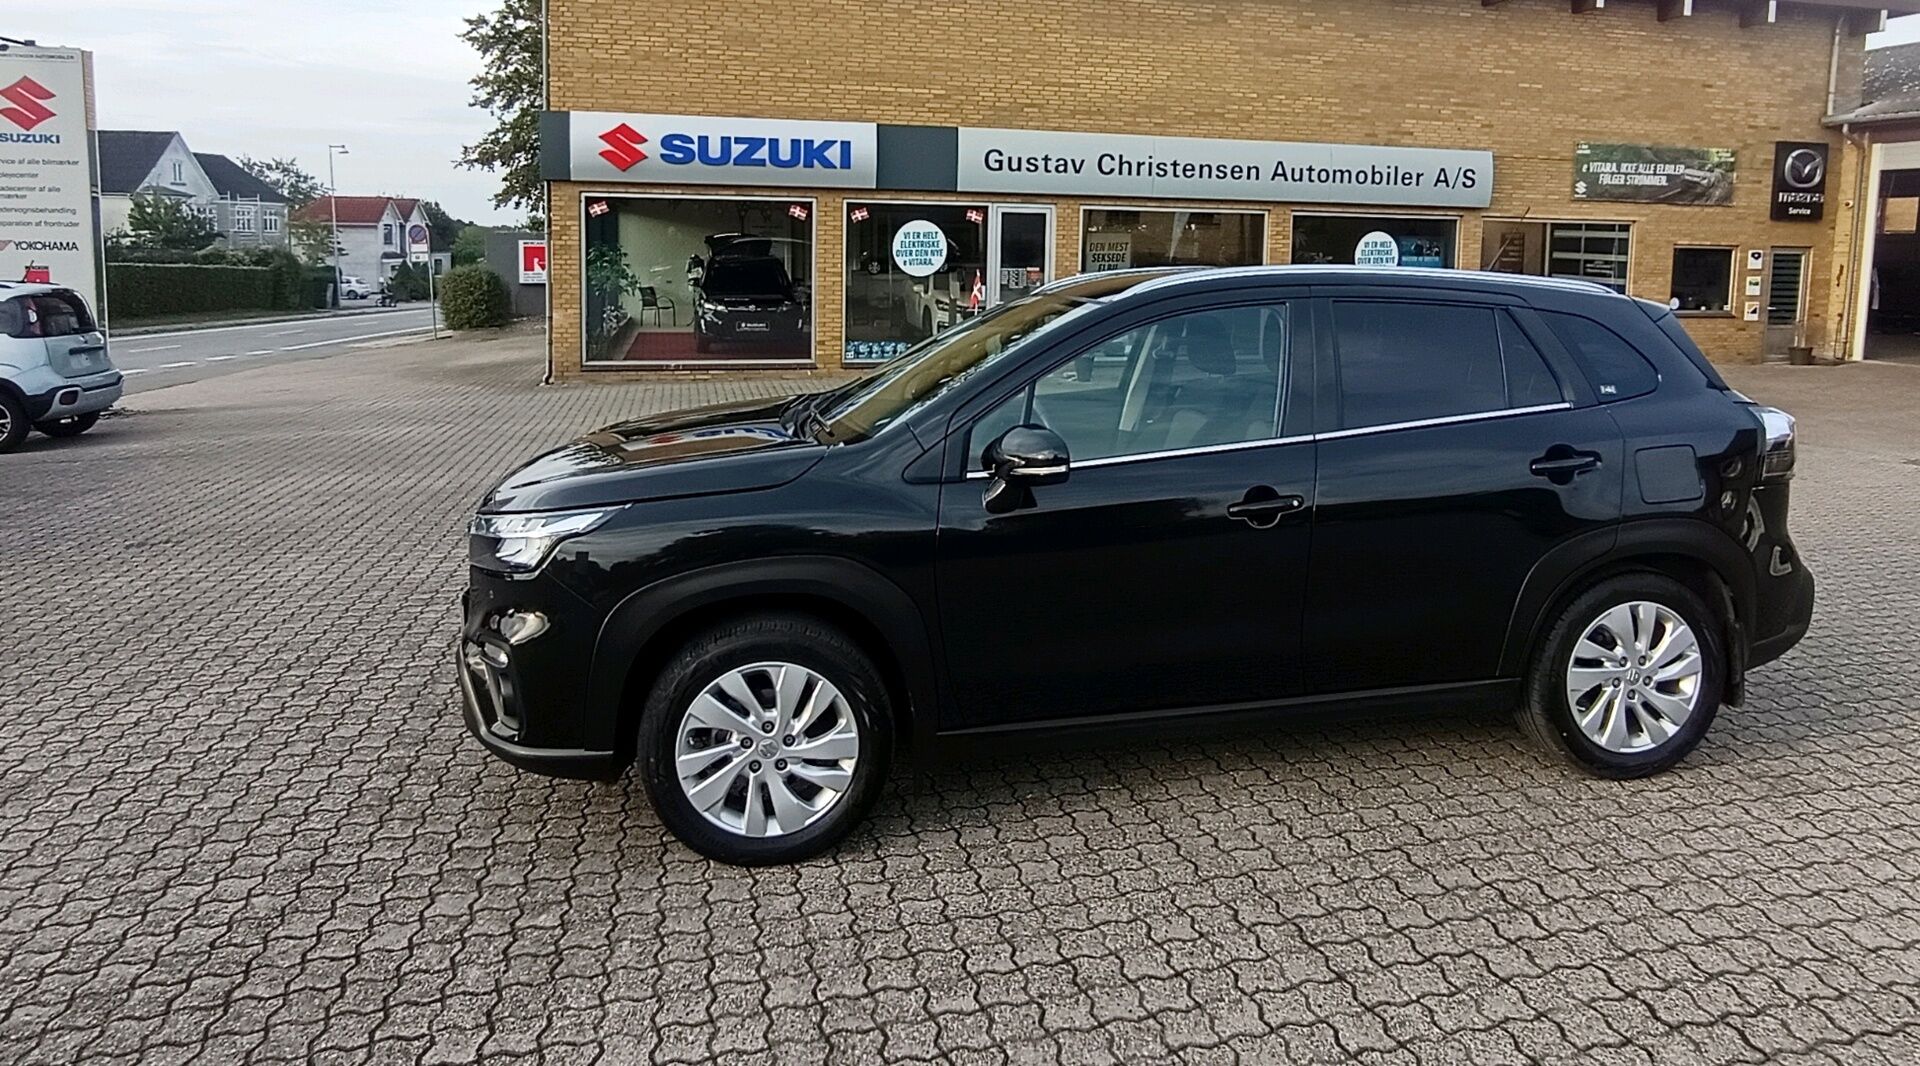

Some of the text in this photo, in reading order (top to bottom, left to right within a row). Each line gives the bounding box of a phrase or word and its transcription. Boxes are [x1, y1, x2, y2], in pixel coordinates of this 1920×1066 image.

[0, 132, 60, 144] SUZUKI
[660, 133, 852, 170] SUZUKI
[983, 148, 1477, 190] Gustav Christensen Automobiler A/S
[1619, 162, 1637, 174] IKKE
[1637, 163, 1656, 174] ALLE
[1656, 163, 1685, 175] ELBILER
[1788, 206, 1811, 215] Service
[13, 240, 80, 252] YOKOHAMA
[900, 240, 940, 248] ELEKTRISKE
[1089, 242, 1129, 252] DEN MEST
[896, 249, 944, 258] OVER DEN NYE
